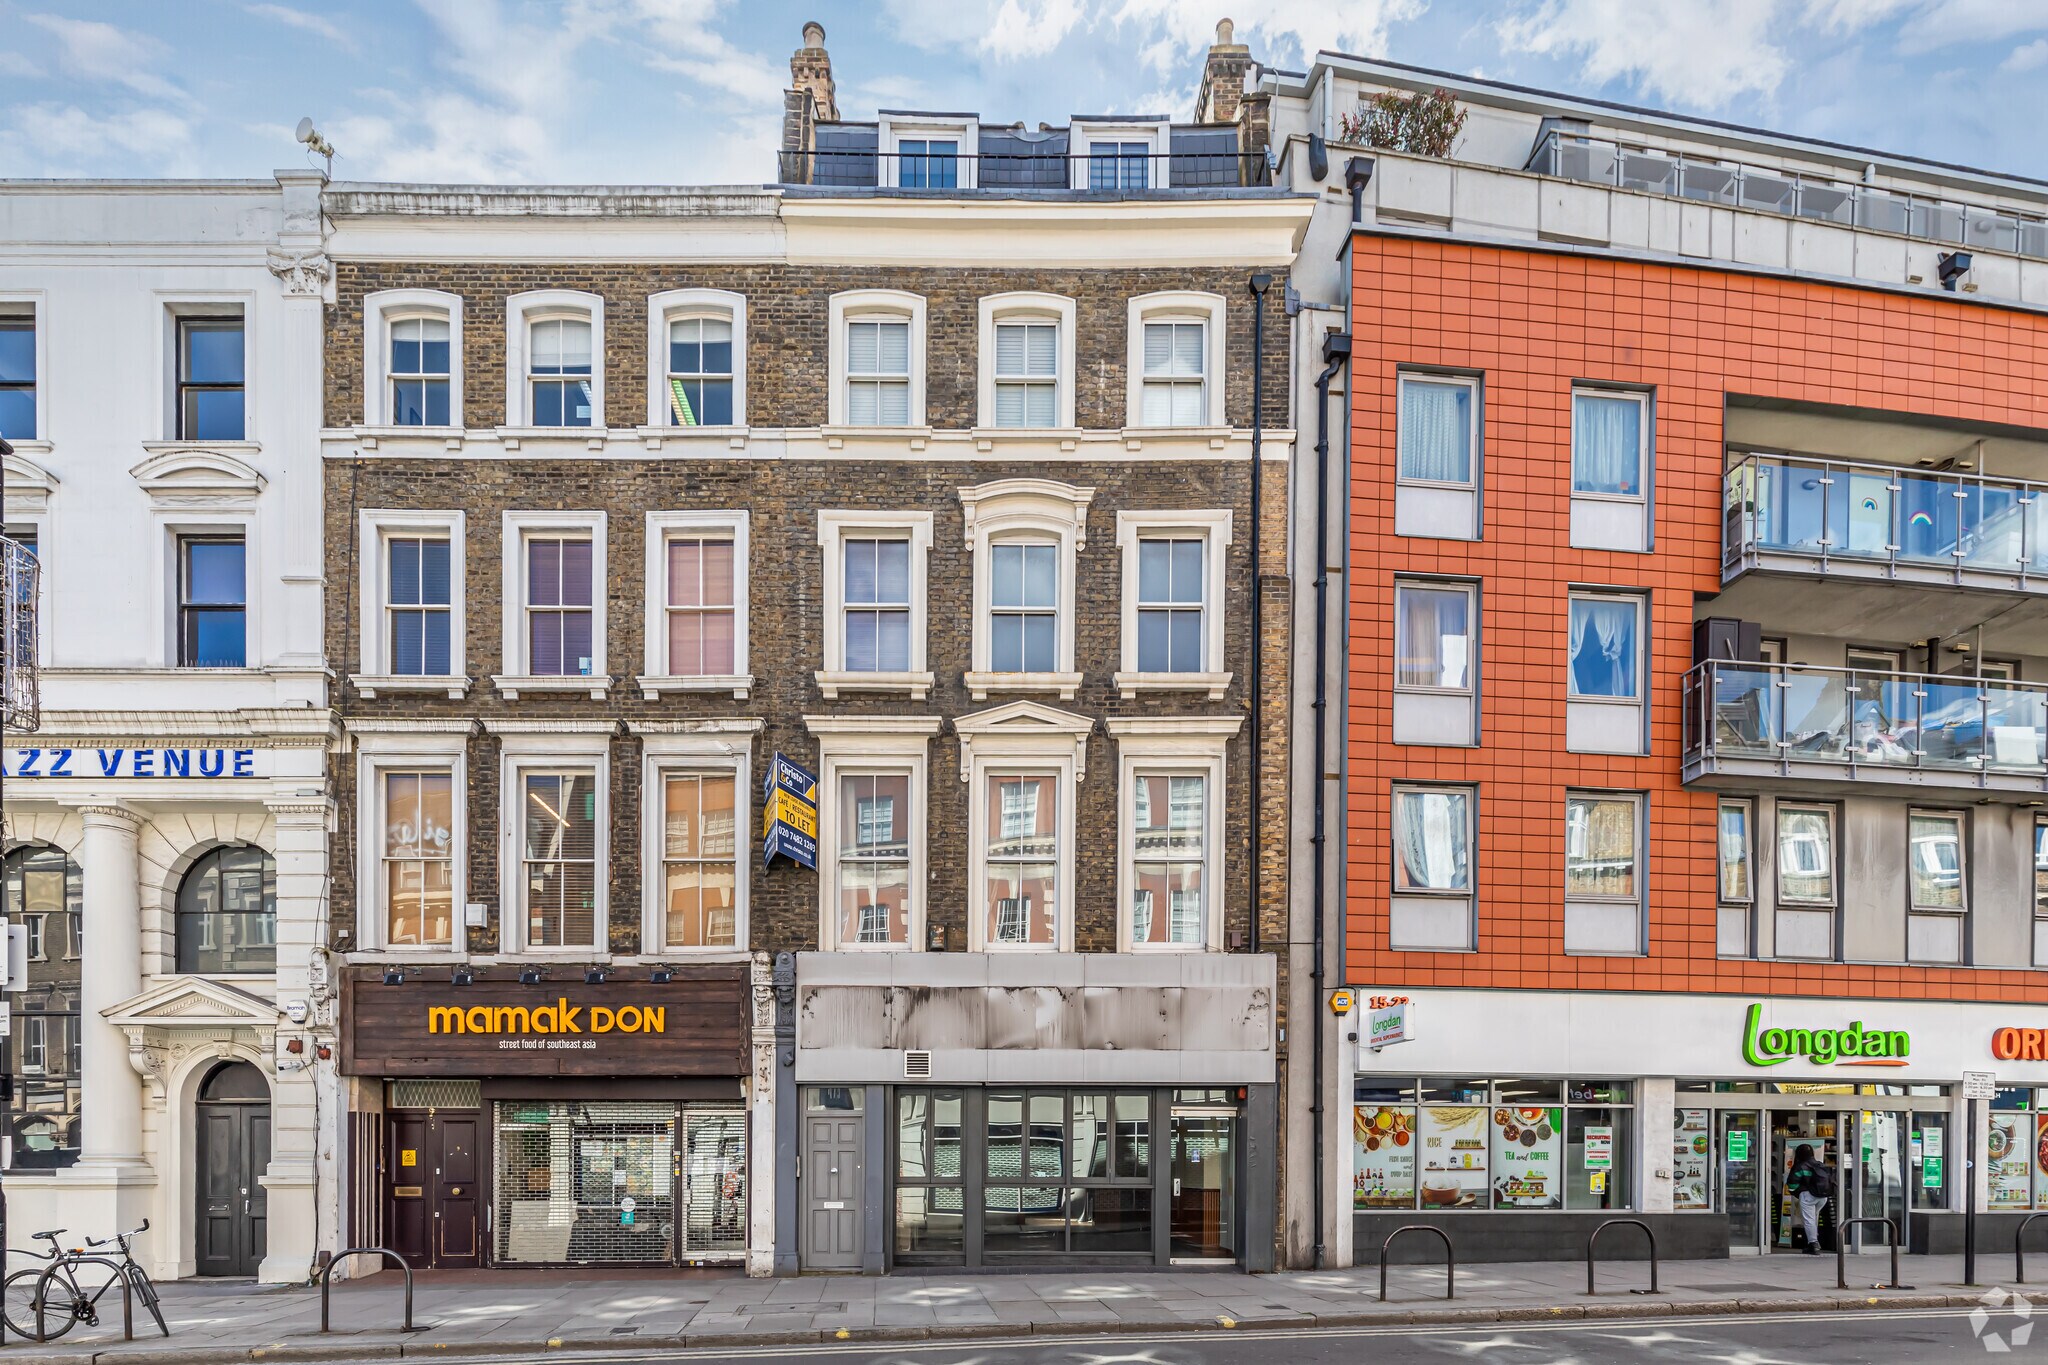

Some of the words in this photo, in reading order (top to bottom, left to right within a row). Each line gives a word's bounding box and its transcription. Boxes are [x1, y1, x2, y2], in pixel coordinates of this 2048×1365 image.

[98, 749, 254, 776] VENUE
[780, 762, 803, 784] Christo
[785, 810, 795, 825] TO
[797, 818, 810, 833] LET
[792, 804, 816, 823] RESTAURANT
[778, 825, 789, 839] 020
[429, 998, 583, 1034] mamak
[590, 1005, 665, 1034] DON
[1372, 1013, 1401, 1035] Longdan
[499, 1039, 519, 1049] street
[521, 1039, 537, 1049] food
[538, 1039, 545, 1049] of
[546, 1039, 581, 1049] southeast
[582, 1040, 596, 1049] asia
[1742, 1003, 1911, 1066] Longdan
[1427, 1137, 1442, 1148] RICE
[1505, 1151, 1515, 1160] TEA
[1516, 1152, 1529, 1161] and
[1530, 1151, 1549, 1161] COFFEE
